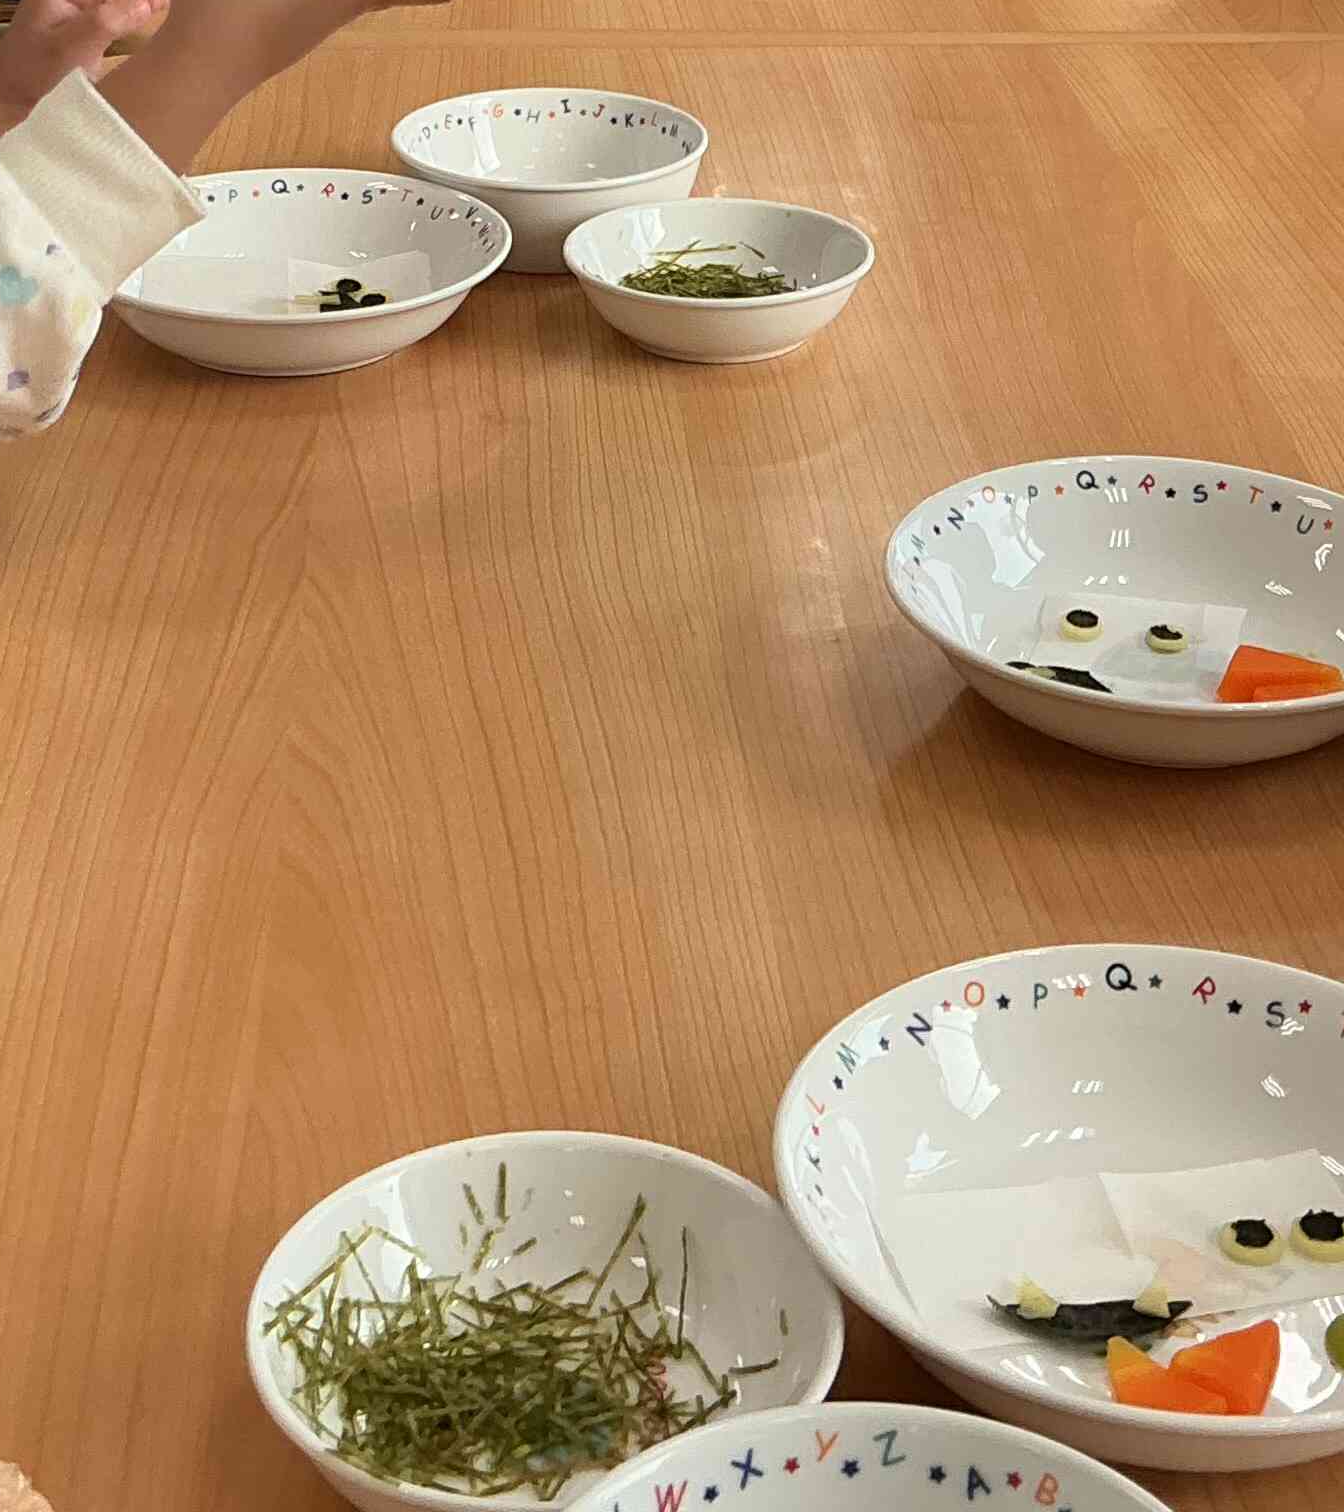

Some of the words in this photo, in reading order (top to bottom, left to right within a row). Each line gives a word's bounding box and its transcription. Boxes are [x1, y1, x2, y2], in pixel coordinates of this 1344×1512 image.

[444, 114, 452, 130] E
[492, 104, 504, 118] G
[526, 109, 541, 124] H
[561, 99, 571, 113] I
[592, 103, 606, 118] J
[624, 112, 634, 128] K
[228, 189, 238, 202] P
[272, 179, 290, 194] Q
[321, 183, 335, 198] R
[361, 190, 373, 204] S
[399, 189, 412, 202] T
[430, 207, 443, 220] U
[465, 206, 479, 219] V
[947, 507, 965, 530] N
[983, 486, 995, 503] O
[1028, 485, 1038, 504] P
[1076, 470, 1099, 490] Q
[1139, 473, 1155, 494] R
[1193, 484, 1208, 504] S
[1249, 486, 1264, 504] T
[1296, 514, 1314, 535] U
[806, 1094, 825, 1114] L
[835, 1042, 860, 1074] M
[906, 1013, 932, 1046] N
[964, 981, 985, 1007] O
[1034, 983, 1048, 1009] P
[1105, 963, 1138, 991] Q
[1192, 976, 1217, 1004] R
[1265, 1001, 1285, 1028] S
[654, 1480, 688, 1512] W
[730, 1447, 764, 1490] X
[815, 1430, 840, 1463] Y
[873, 1429, 908, 1467] Z
[966, 1465, 991, 1500] A
[1034, 1472, 1059, 1506] B
